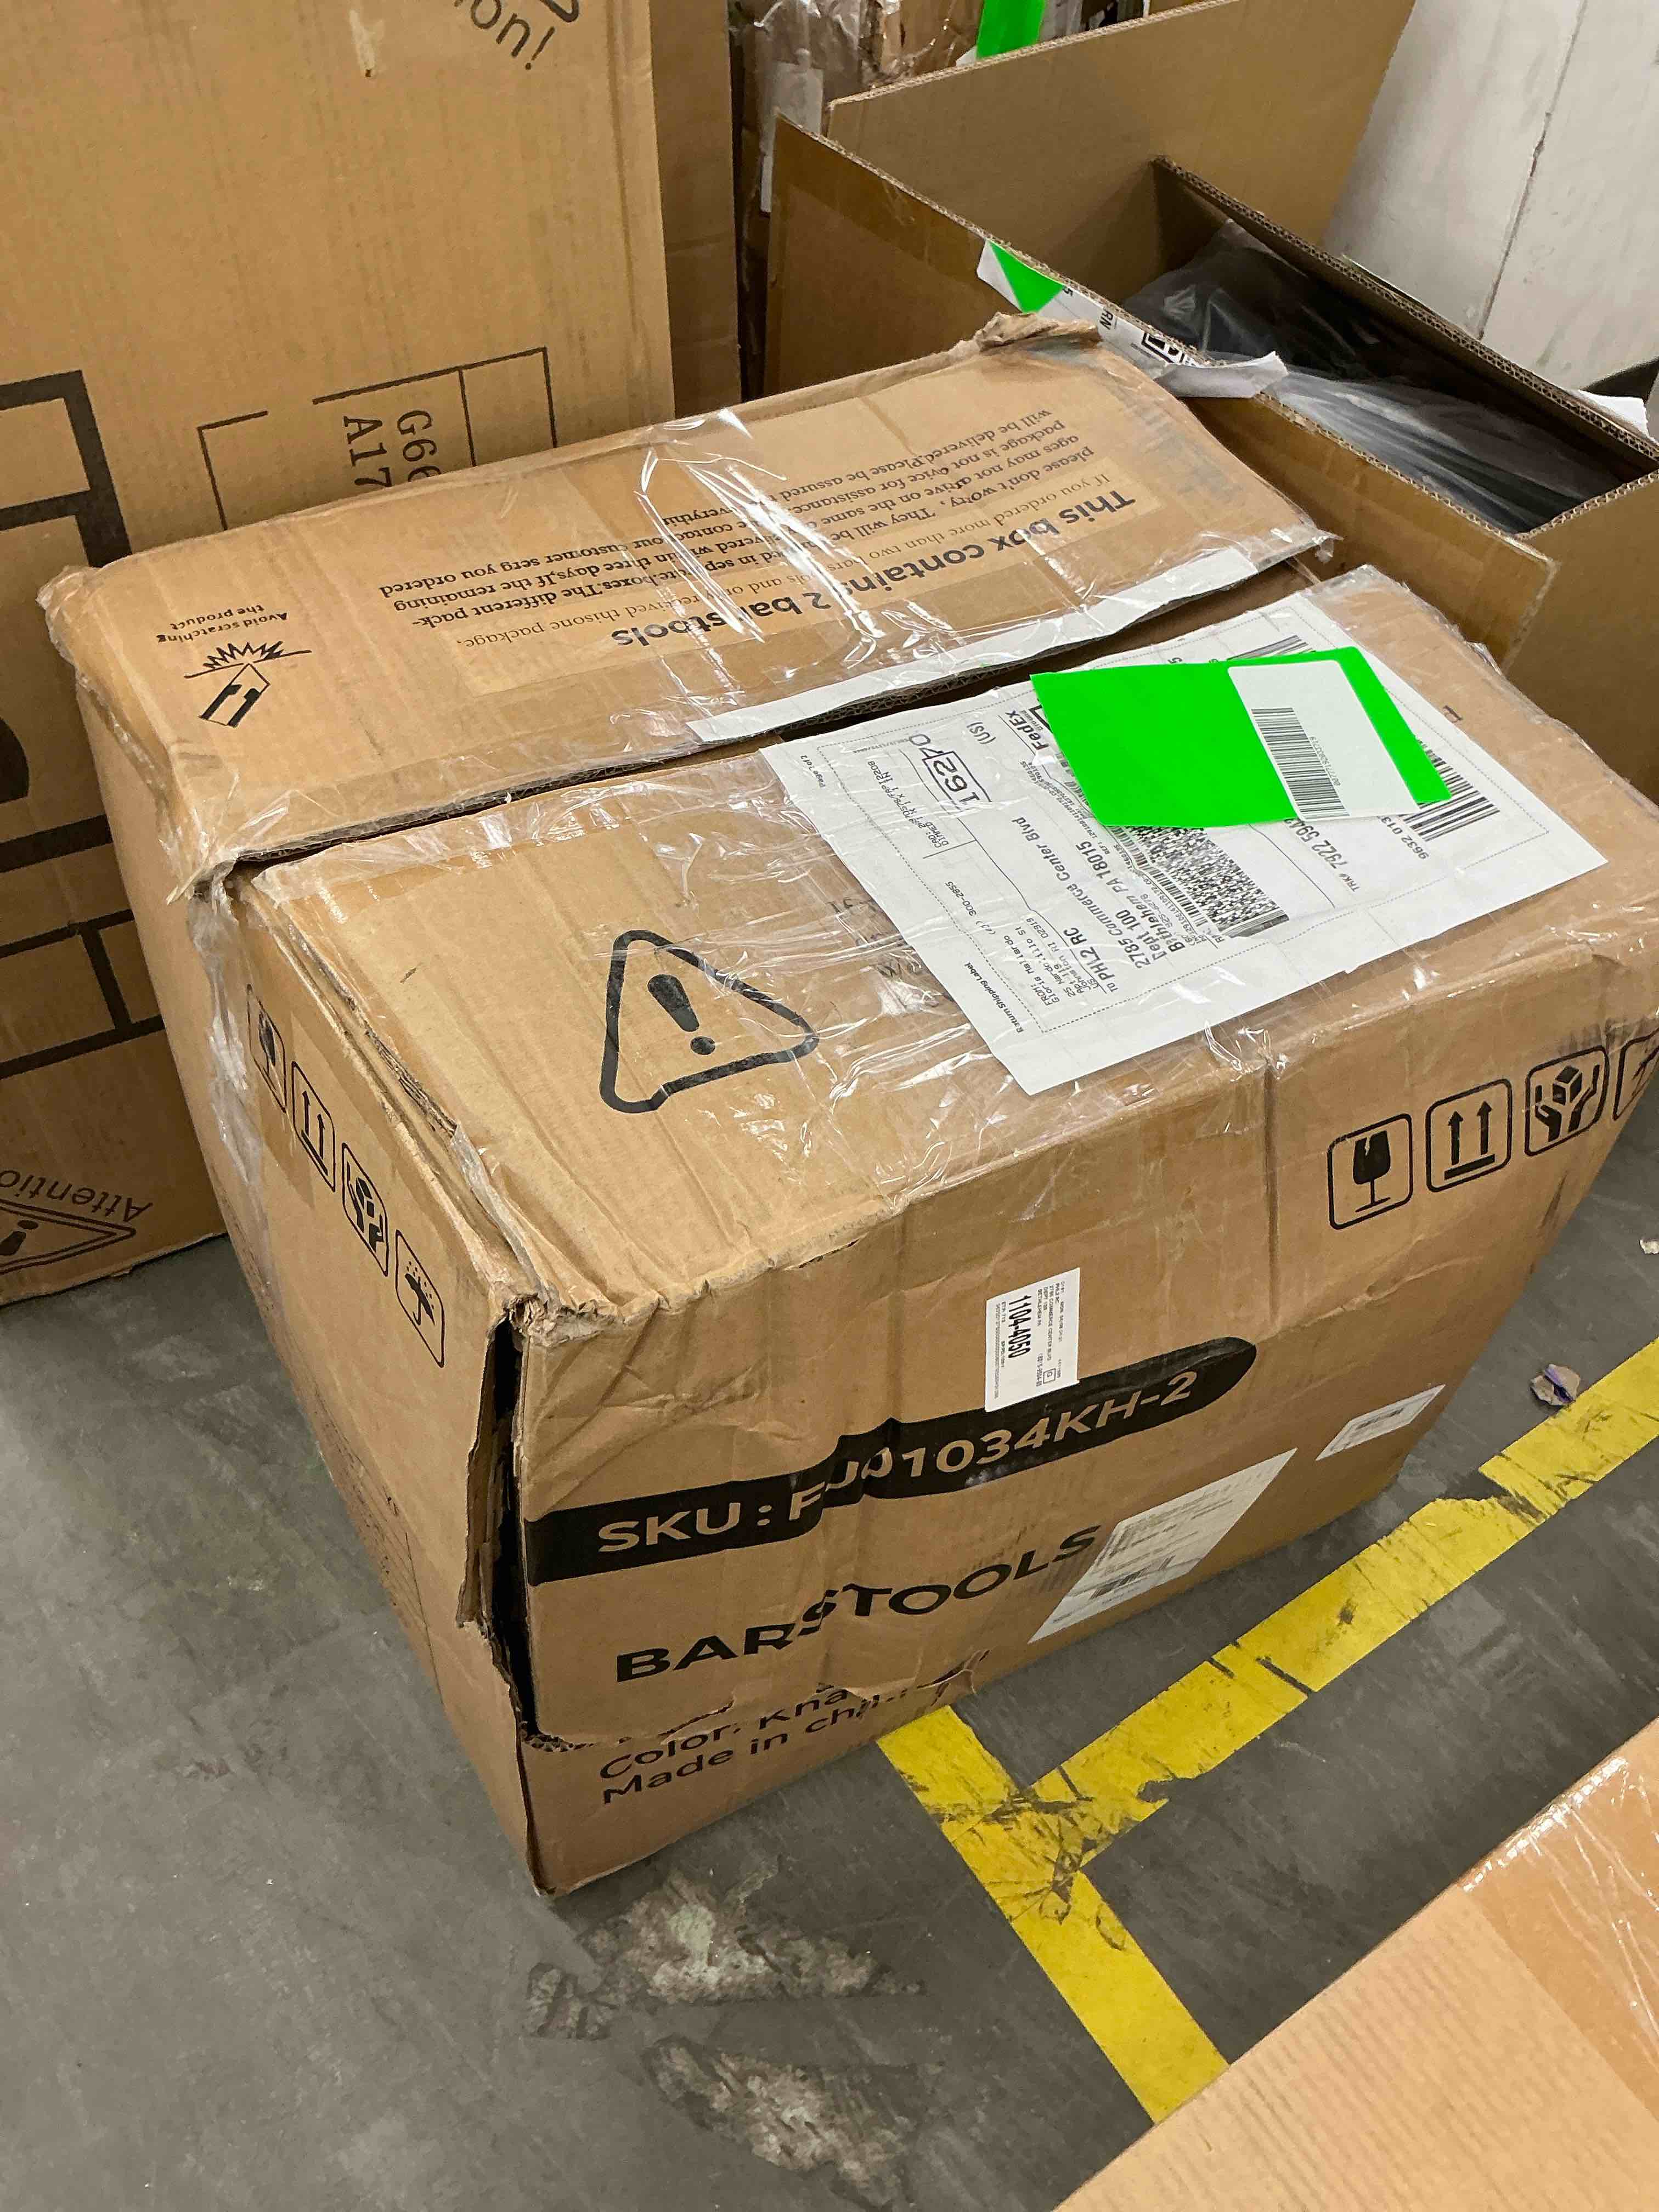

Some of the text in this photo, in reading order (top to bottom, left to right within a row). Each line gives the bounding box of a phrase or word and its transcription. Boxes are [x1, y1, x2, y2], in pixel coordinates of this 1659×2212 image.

[454, 0, 555, 70] on!
[998, 422, 1022, 433] be
[1020, 410, 1053, 427] will
[998, 421, 1065, 451] package
[1043, 436, 1079, 453] ages
[951, 454, 980, 469] not
[983, 448, 999, 458] is
[1007, 450, 1041, 467] may
[1041, 446, 1094, 471] please
[845, 470, 871, 485] be
[974, 465, 1003, 479] not
[1002, 470, 1040, 490] don't
[1094, 474, 1110, 486] If
[779, 478, 843, 501] assured
[877, 477, 907, 493] for
[1063, 478, 1091, 495] you
[866, 498, 898, 515] the
[896, 490, 923, 504] on
[1059, 491, 1136, 523] This
[821, 508, 865, 524] same
[891, 508, 935, 524] They
[994, 494, 1057, 525] ordered
[668, 524, 732, 541] contac
[831, 531, 854, 540] be
[854, 521, 888, 537] will
[949, 520, 991, 535] more
[986, 518, 1059, 551] box
[905, 533, 944, 548] than
[737, 556, 759, 565] in
[870, 546, 901, 558] two
[461, 564, 498, 579] you
[379, 575, 456, 597] ordered
[499, 575, 533, 595] the
[748, 579, 781, 594] and
[394, 585, 496, 611] remaining
[471, 592, 556, 615] different
[802, 592, 832, 609] 2
[170, 602, 264, 630] the product
[156, 613, 287, 642] Avoid scratching
[967, 722, 996, 744] (US)
[1005, 710, 1049, 750] FedEx
[1012, 817, 1040, 841] Blvd
[1376, 816, 1429, 859] 9632 013
[926, 832, 944, 848] CAD:
[1036, 845, 1070, 881] Center
[1076, 842, 1110, 878] 18015
[1312, 840, 1347, 868] 7922
[1106, 878, 1128, 893] PA
[1066, 884, 1122, 935] Commerce
[1015, 927, 1025, 935] St
[1116, 910, 1167, 960] Dept 100
[1064, 928, 1118, 992] TO PHL2 RC
[1118, 939, 1150, 968] 2785
[964, 963, 982, 980] Label
[980, 980, 1006, 1008] Shipping
[1031, 984, 1053, 1006] FROM:
[1034, 977, 1059, 1002] Gloria
[1063, 988, 1076, 997] 25
[1008, 1295, 1032, 1359] 1104-4050
[617, 1525, 1101, 1683] BARSTOOLS
[603, 1750, 734, 1804] Made
[751, 1733, 788, 1755] in
